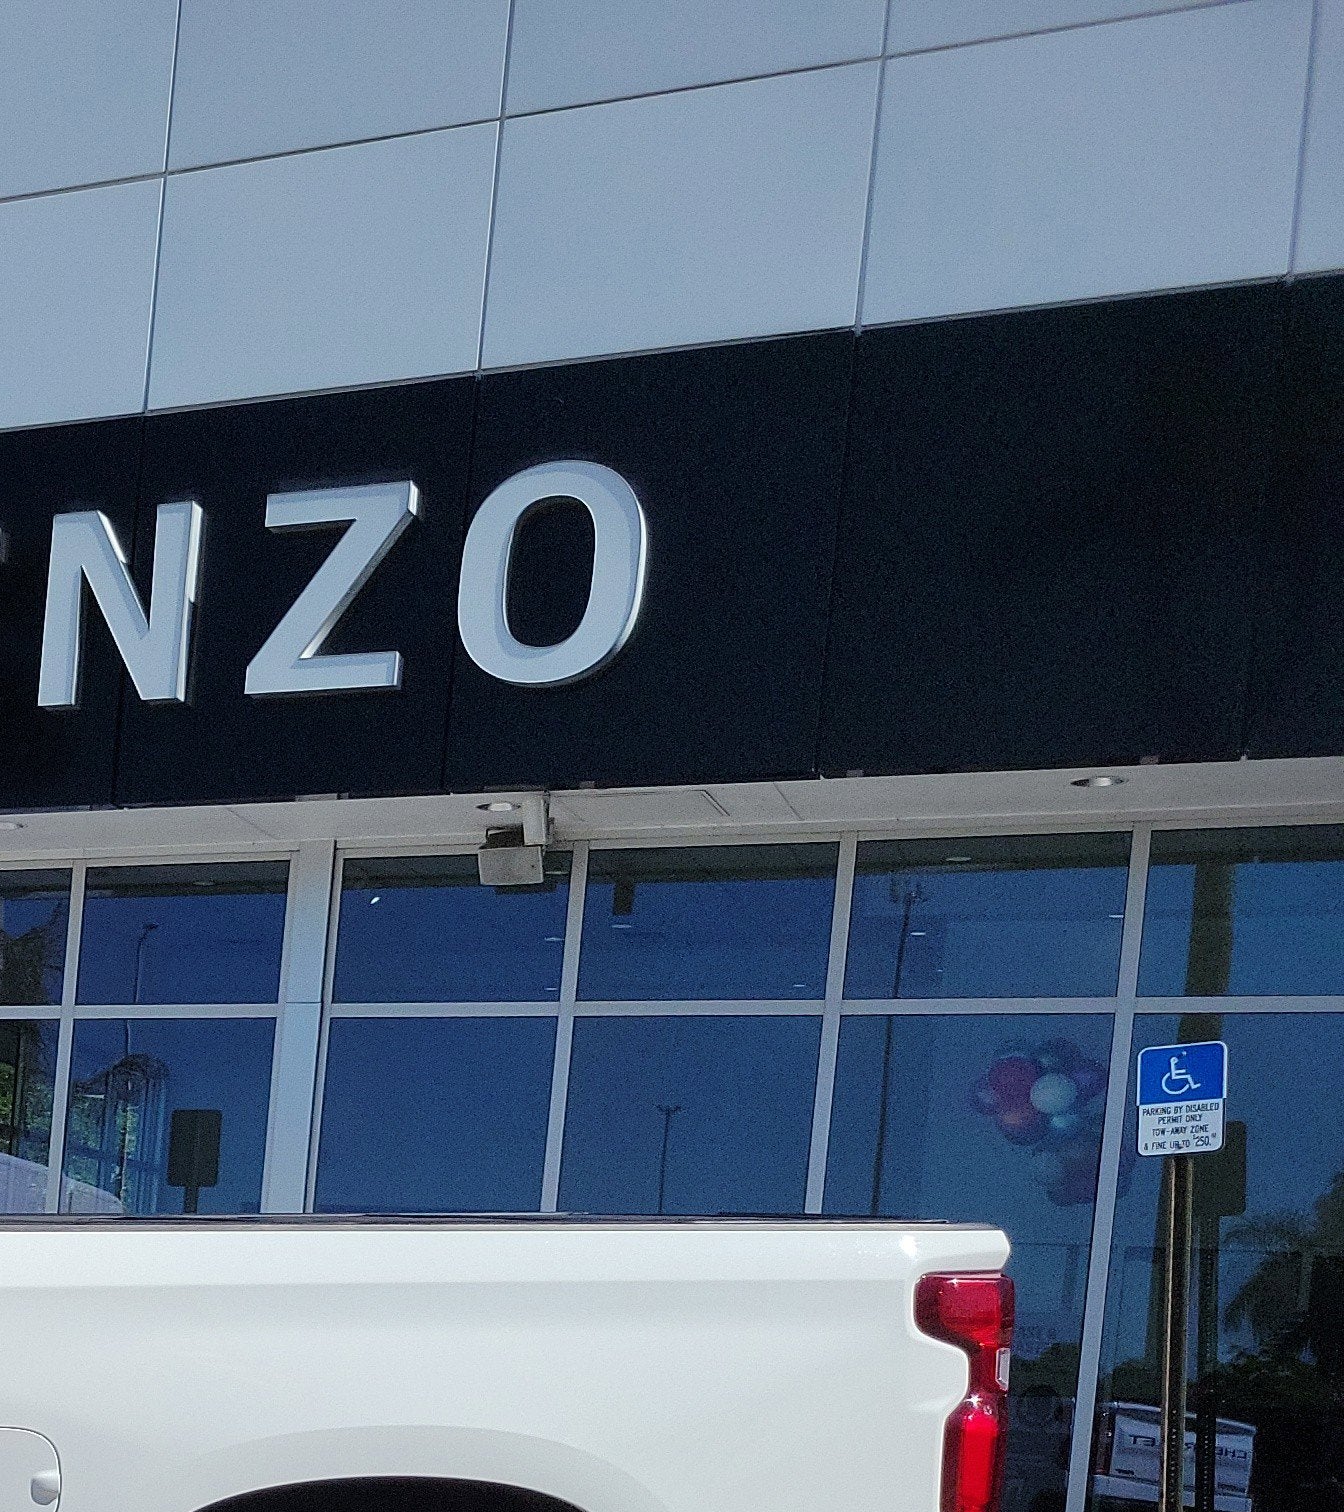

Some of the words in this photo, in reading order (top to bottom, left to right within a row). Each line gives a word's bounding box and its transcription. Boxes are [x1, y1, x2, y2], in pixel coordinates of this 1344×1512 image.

[1142, 1106, 1172, 1117] PARKING
[1173, 1106, 1183, 1115] BY
[1185, 1102, 1220, 1113] DISABLED
[1157, 1116, 1182, 1125] PERMIT
[1185, 1113, 1203, 1123] ONLY
[1189, 1124, 1209, 1134] ZONE
[1151, 1141, 1167, 1151] FINE
